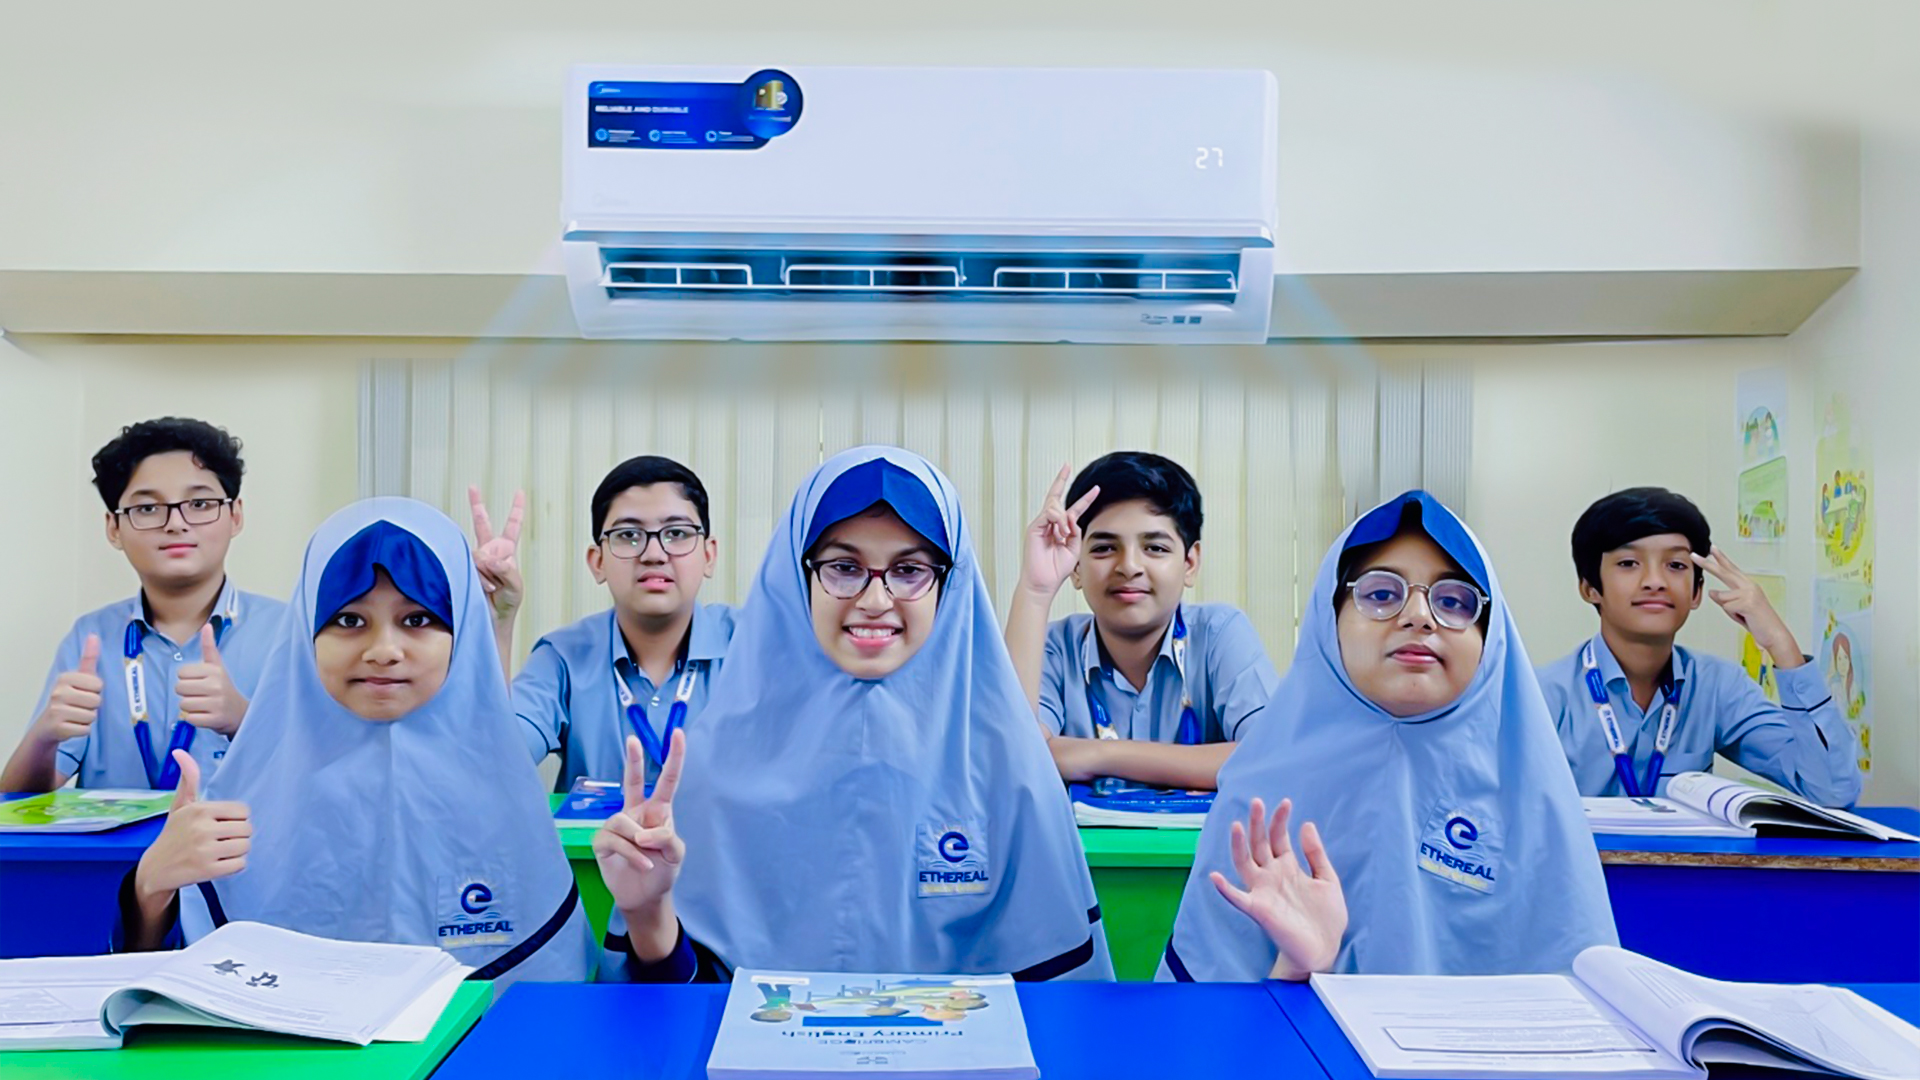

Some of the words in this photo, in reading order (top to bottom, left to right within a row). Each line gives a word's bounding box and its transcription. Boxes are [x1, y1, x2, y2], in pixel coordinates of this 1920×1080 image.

[1195, 147, 1223, 169] 27
[1420, 842, 1495, 881] ETHEREAL
[919, 870, 989, 883] ETHEREAL
[438, 921, 514, 937] ETHEREAL
[781, 1029, 865, 1038] English
[873, 1029, 964, 1038] Primary
